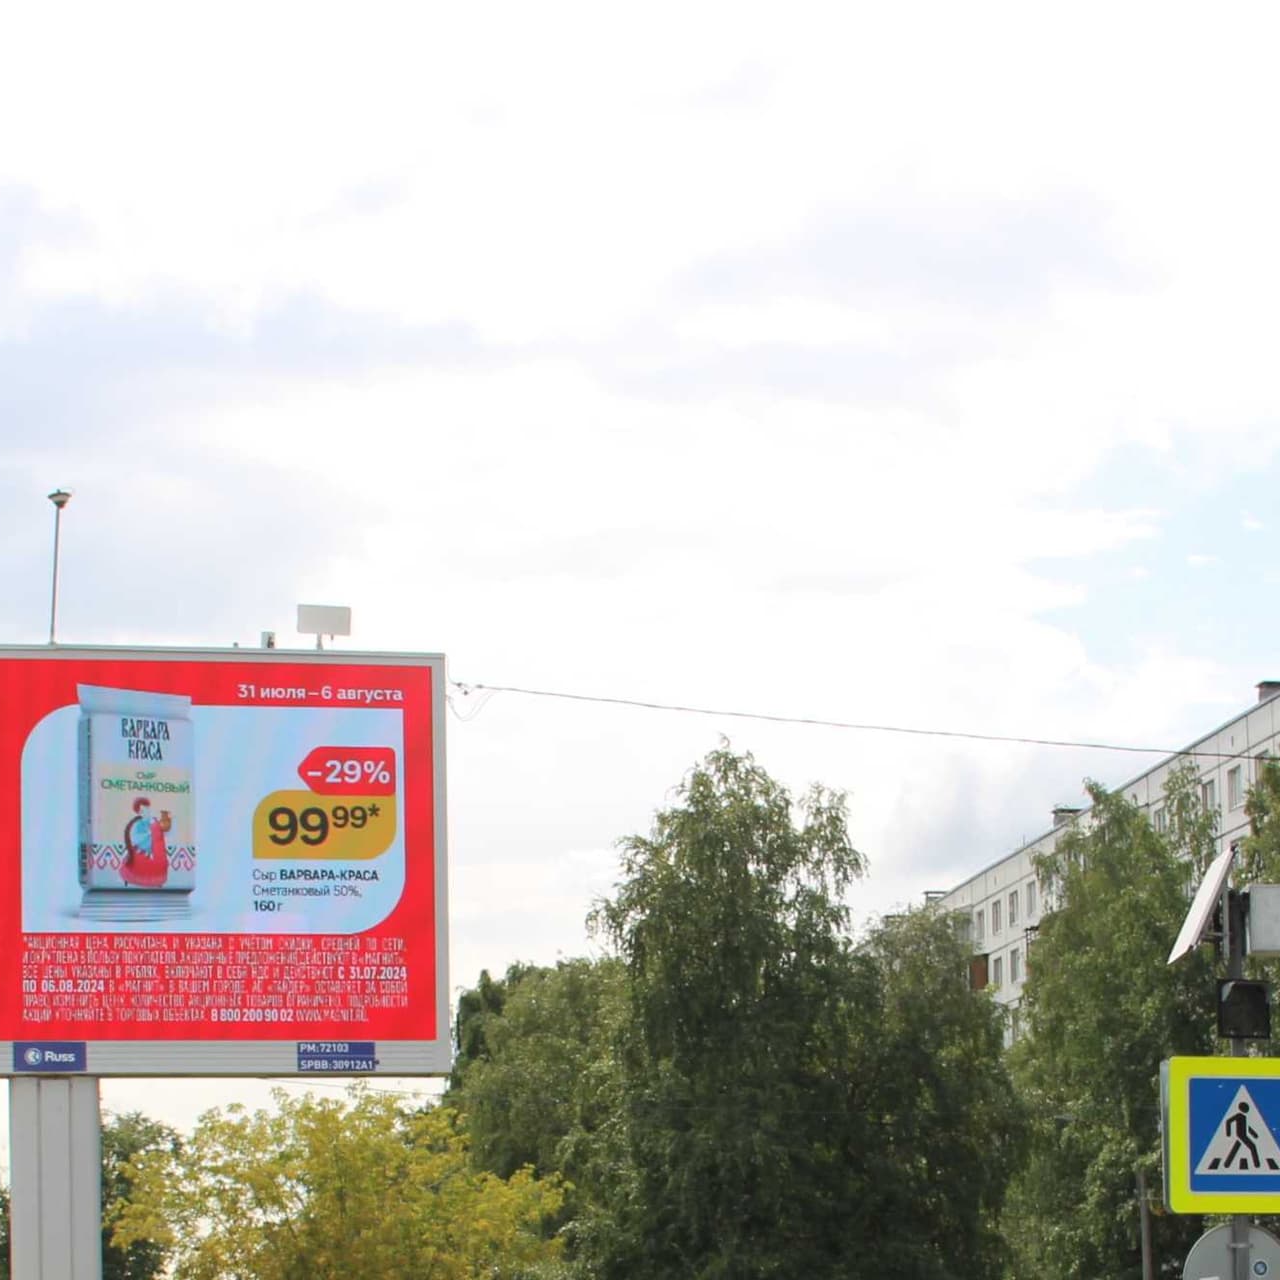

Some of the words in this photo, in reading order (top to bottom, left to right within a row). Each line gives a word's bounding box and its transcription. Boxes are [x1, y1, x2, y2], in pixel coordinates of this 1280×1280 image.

[238, 685, 255, 699] 31
[337, 688, 404, 703] августа
[121, 718, 170, 740] ВАРВАРА
[128, 739, 163, 761] КРАСА
[101, 778, 190, 794] СМЕТАНКОВЫЙ
[268, 807, 329, 846] 99
[252, 869, 277, 882] Сыр
[280, 869, 379, 881] ВАРВАРА-КРАСА
[252, 884, 330, 897] Сметанковый
[333, 885, 362, 898] 50%,
[349, 966, 407, 979] 31.07.2024
[41, 980, 104, 993] 06.08.2024
[44, 1051, 75, 1062] Russ
